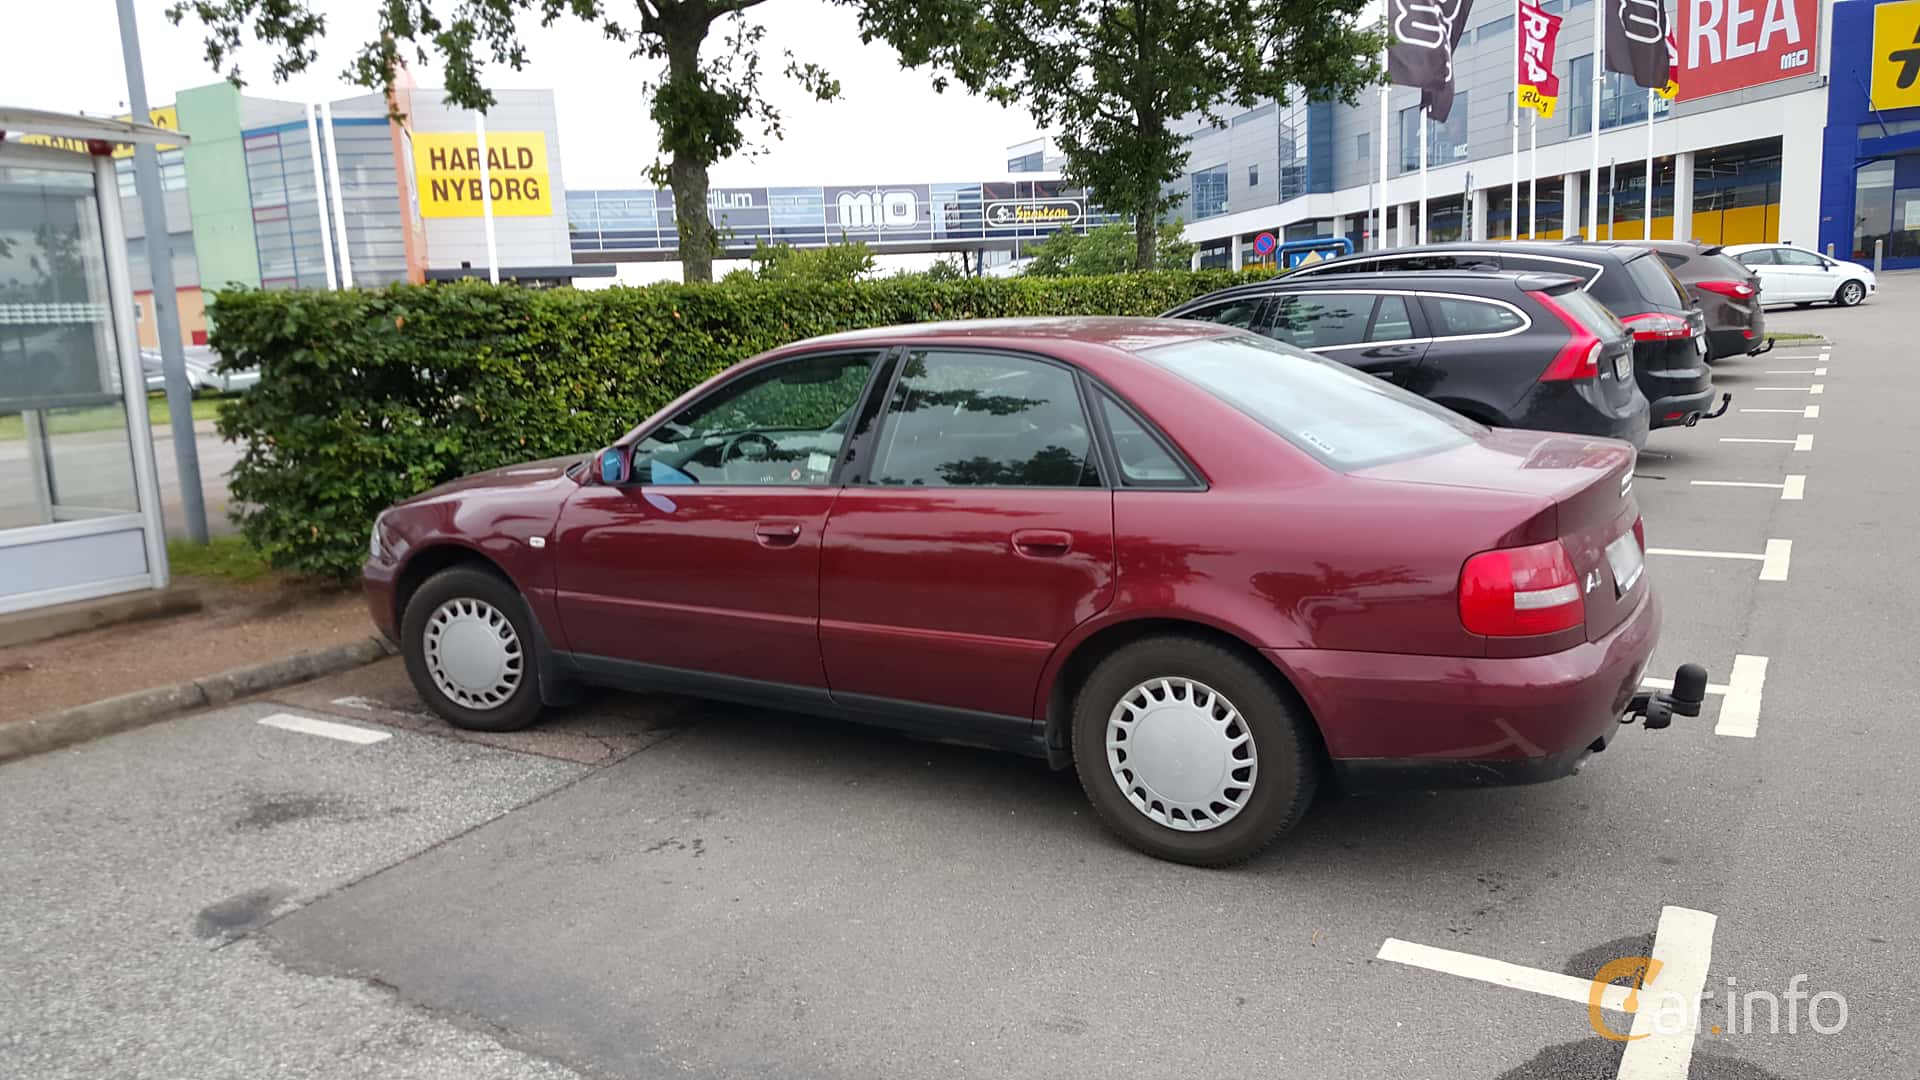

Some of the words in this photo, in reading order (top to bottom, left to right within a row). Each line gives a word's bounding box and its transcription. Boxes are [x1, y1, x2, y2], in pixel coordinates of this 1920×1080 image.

[1522, 6, 1550, 83] REA
[1688, 0, 1801, 70] REA
[429, 146, 534, 171] HARALD
[431, 177, 541, 201] NYBORG
